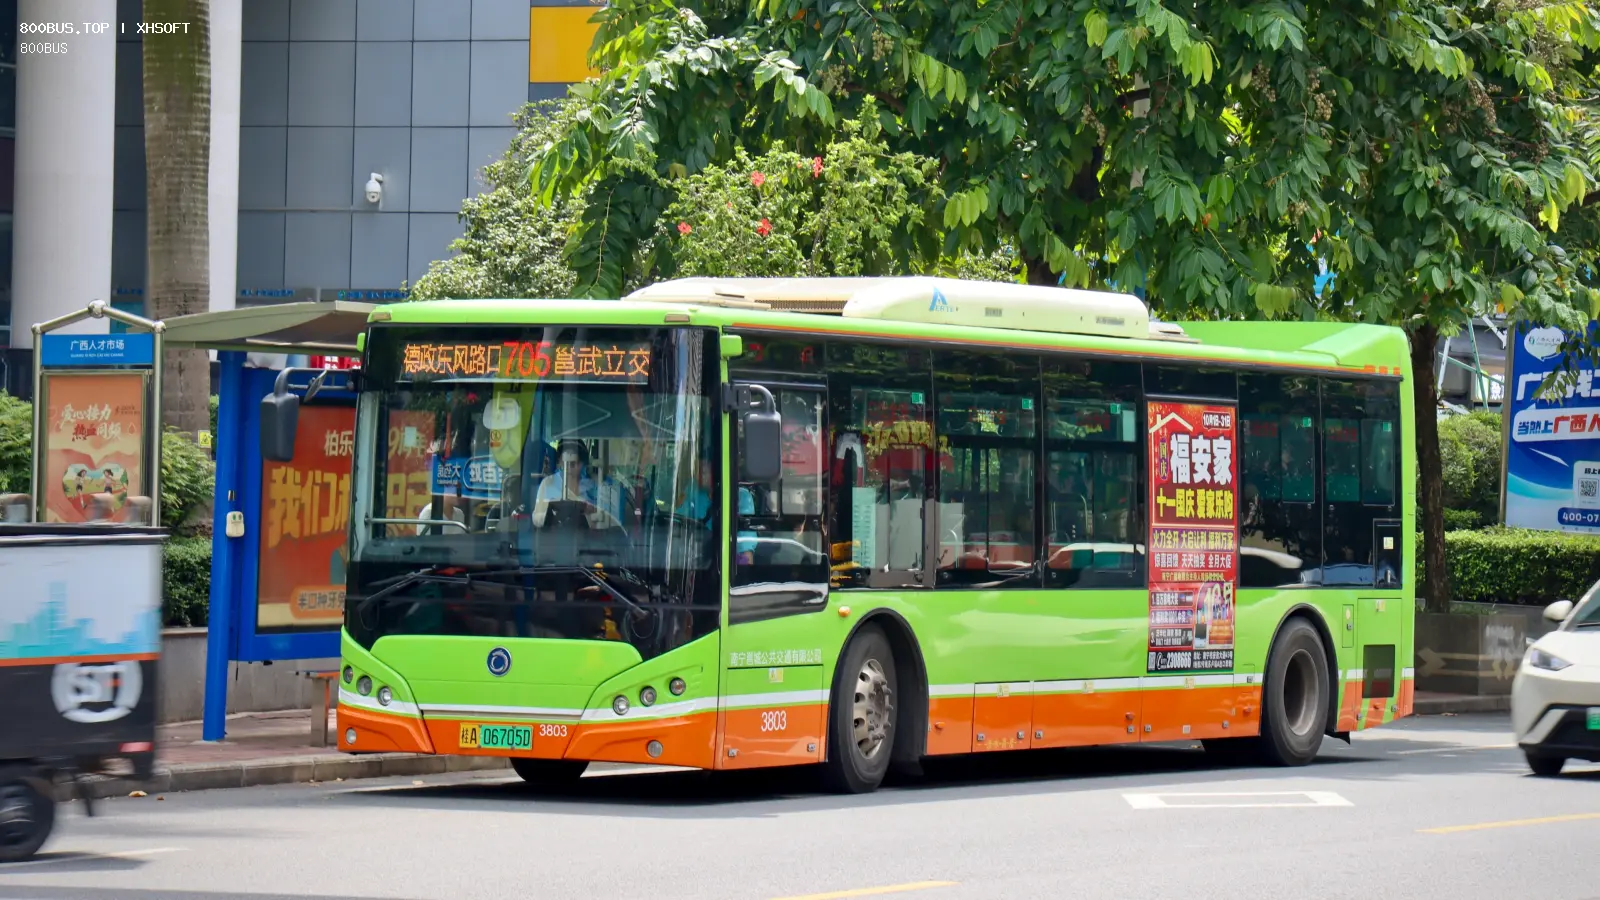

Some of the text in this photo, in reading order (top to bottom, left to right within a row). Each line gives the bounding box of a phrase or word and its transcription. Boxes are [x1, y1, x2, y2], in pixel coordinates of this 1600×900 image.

[70, 339, 125, 351] 广西人才市场
[403, 341, 650, 377] 德政东风路口 705 邕武立交
[60, 403, 112, 428] 爱心接力
[72, 422, 121, 442] 热血同频
[1170, 433, 1232, 486] 福安家
[1157, 487, 1195, 518] 十一国庆
[1153, 530, 1179, 549] 火力全开
[1209, 532, 1234, 550] 福利万家
[1155, 553, 1232, 568] 惊喜回馈 天天抽奖 全月大促
[539, 724, 568, 737] 3803
[761, 710, 787, 732] 3803
